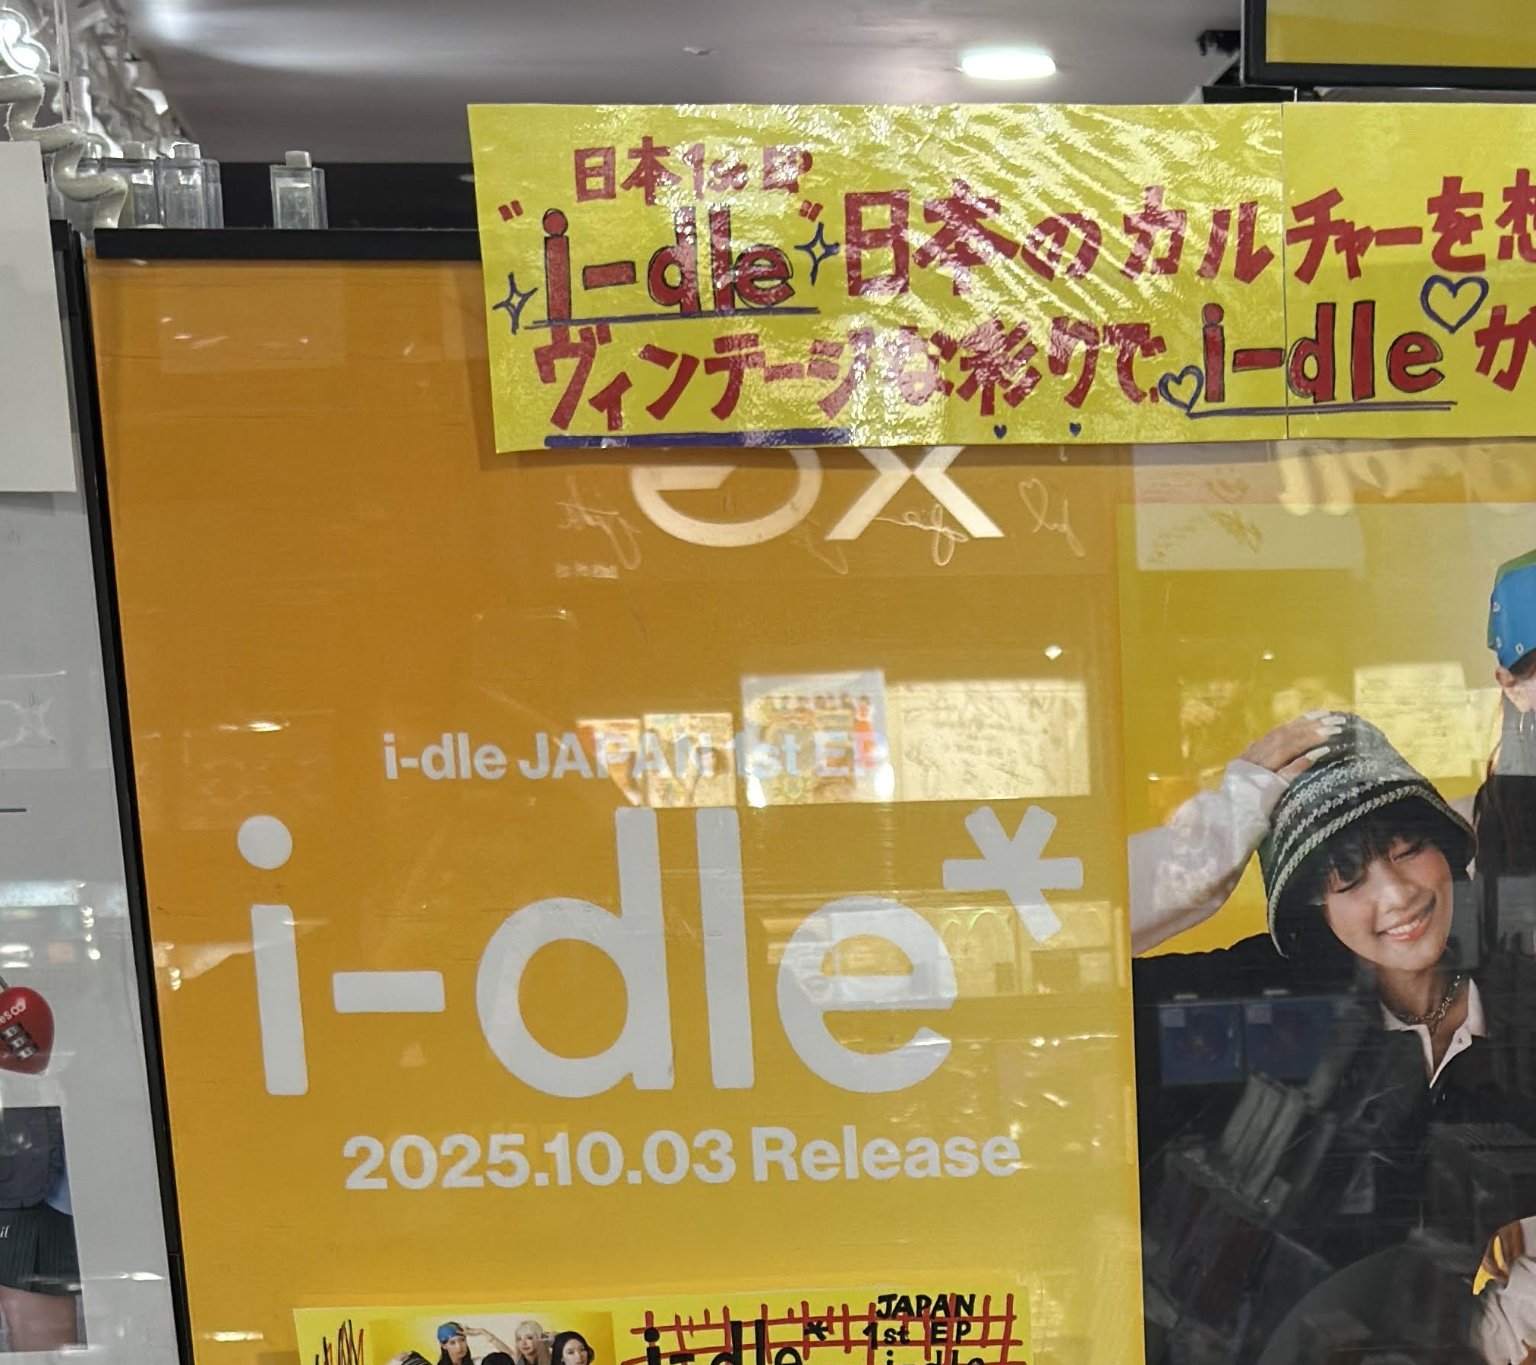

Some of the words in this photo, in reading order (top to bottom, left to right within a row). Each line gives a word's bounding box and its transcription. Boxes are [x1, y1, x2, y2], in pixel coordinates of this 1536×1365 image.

[1203, 301, 1444, 403] i-dle
[383, 732, 506, 780] i-dle
[518, 732, 713, 781] JAPAN
[736, 733, 797, 779] 1st
[820, 732, 888, 778] EP
[343, 1129, 737, 1191] 2025.10.03
[752, 1126, 1021, 1184] Release
[876, 1294, 975, 1319] JAPAN
[863, 1323, 910, 1349] 1st
[931, 1321, 971, 1344] EP
